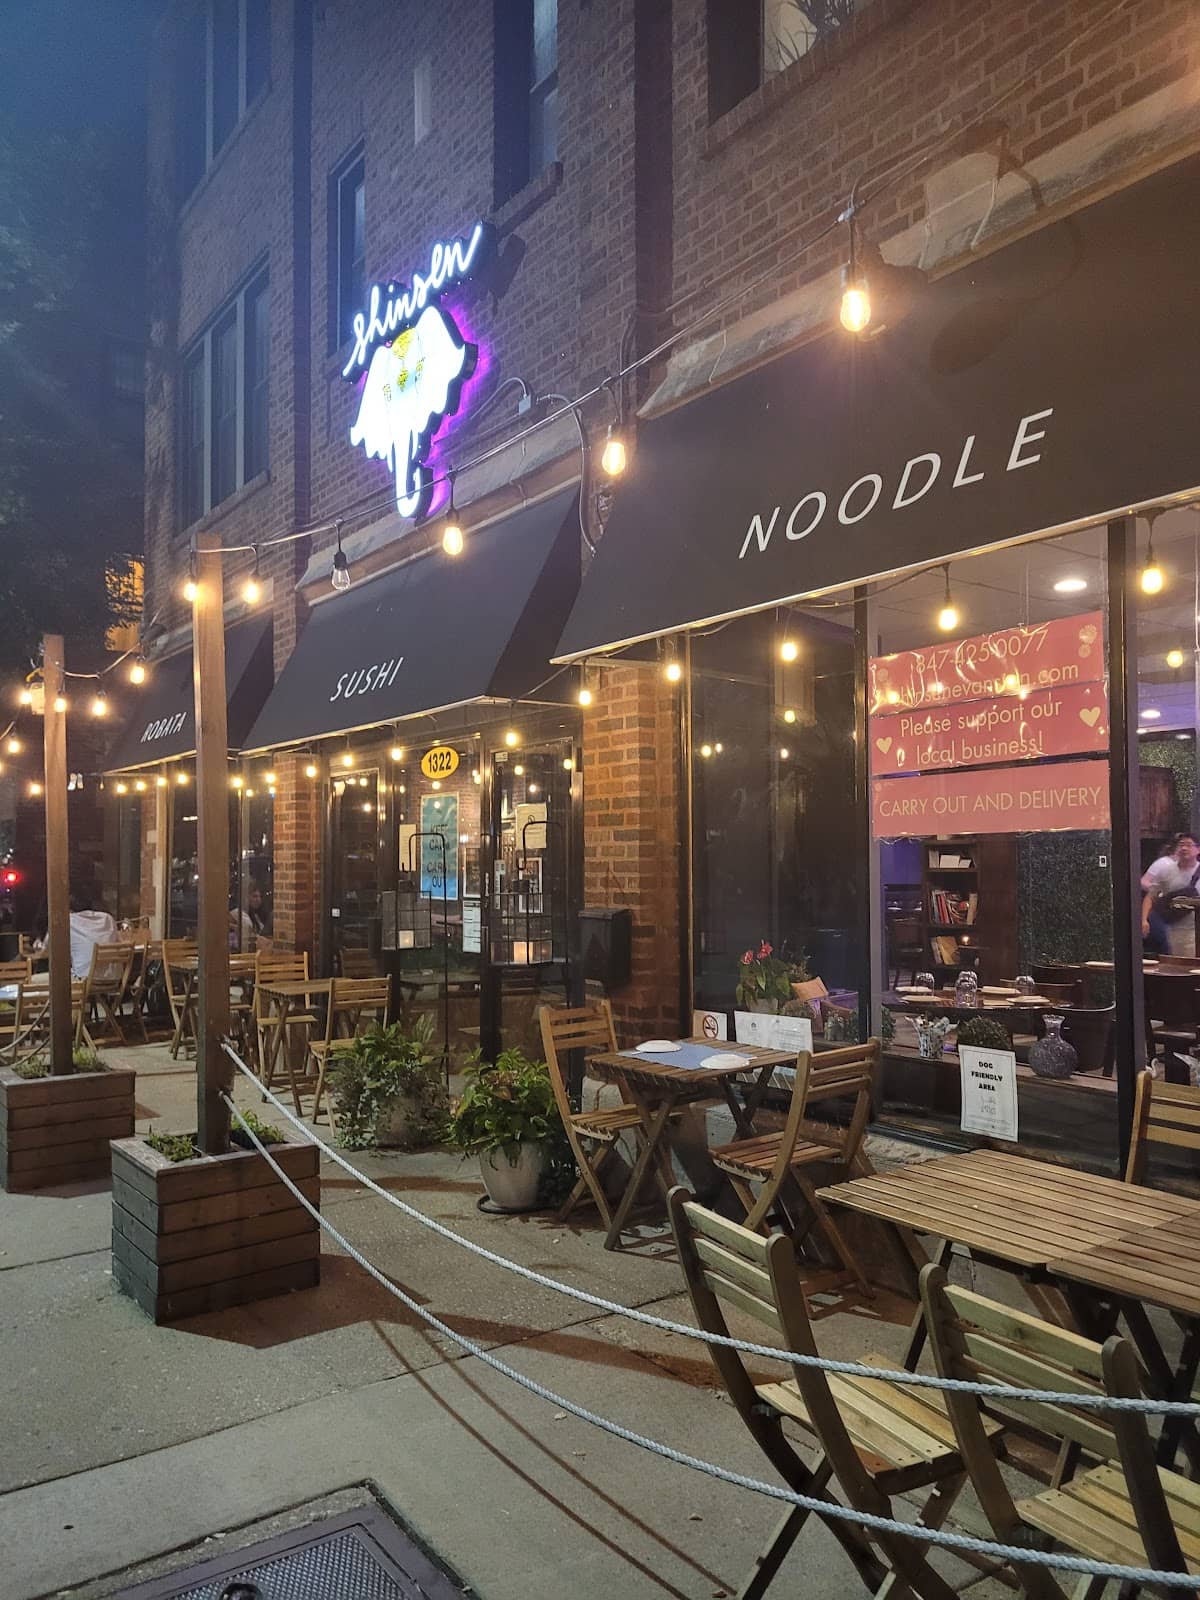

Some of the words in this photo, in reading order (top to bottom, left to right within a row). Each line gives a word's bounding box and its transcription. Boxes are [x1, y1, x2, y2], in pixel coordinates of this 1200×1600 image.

[738, 407, 1054, 560] NOODLE
[329, 656, 404, 702] SUSHI
[889, 663, 1079, 702] hinsenevann.com
[140, 711, 187, 743] ROBATA
[900, 715, 951, 737] Please
[957, 703, 1025, 733] support
[1031, 701, 1063, 718] our
[428, 751, 452, 773] 1322
[916, 740, 955, 766] local
[962, 730, 1044, 760] business!
[879, 798, 928, 818] CARRY
[933, 795, 969, 814] OUT
[973, 792, 1014, 812] AND
[1019, 785, 1102, 809] DELIVERY
[432, 875, 446, 888] OU
[970, 1070, 1003, 1082] FRIENDLY
[978, 1061, 994, 1070] DOG
[978, 1083, 996, 1092] AREA
